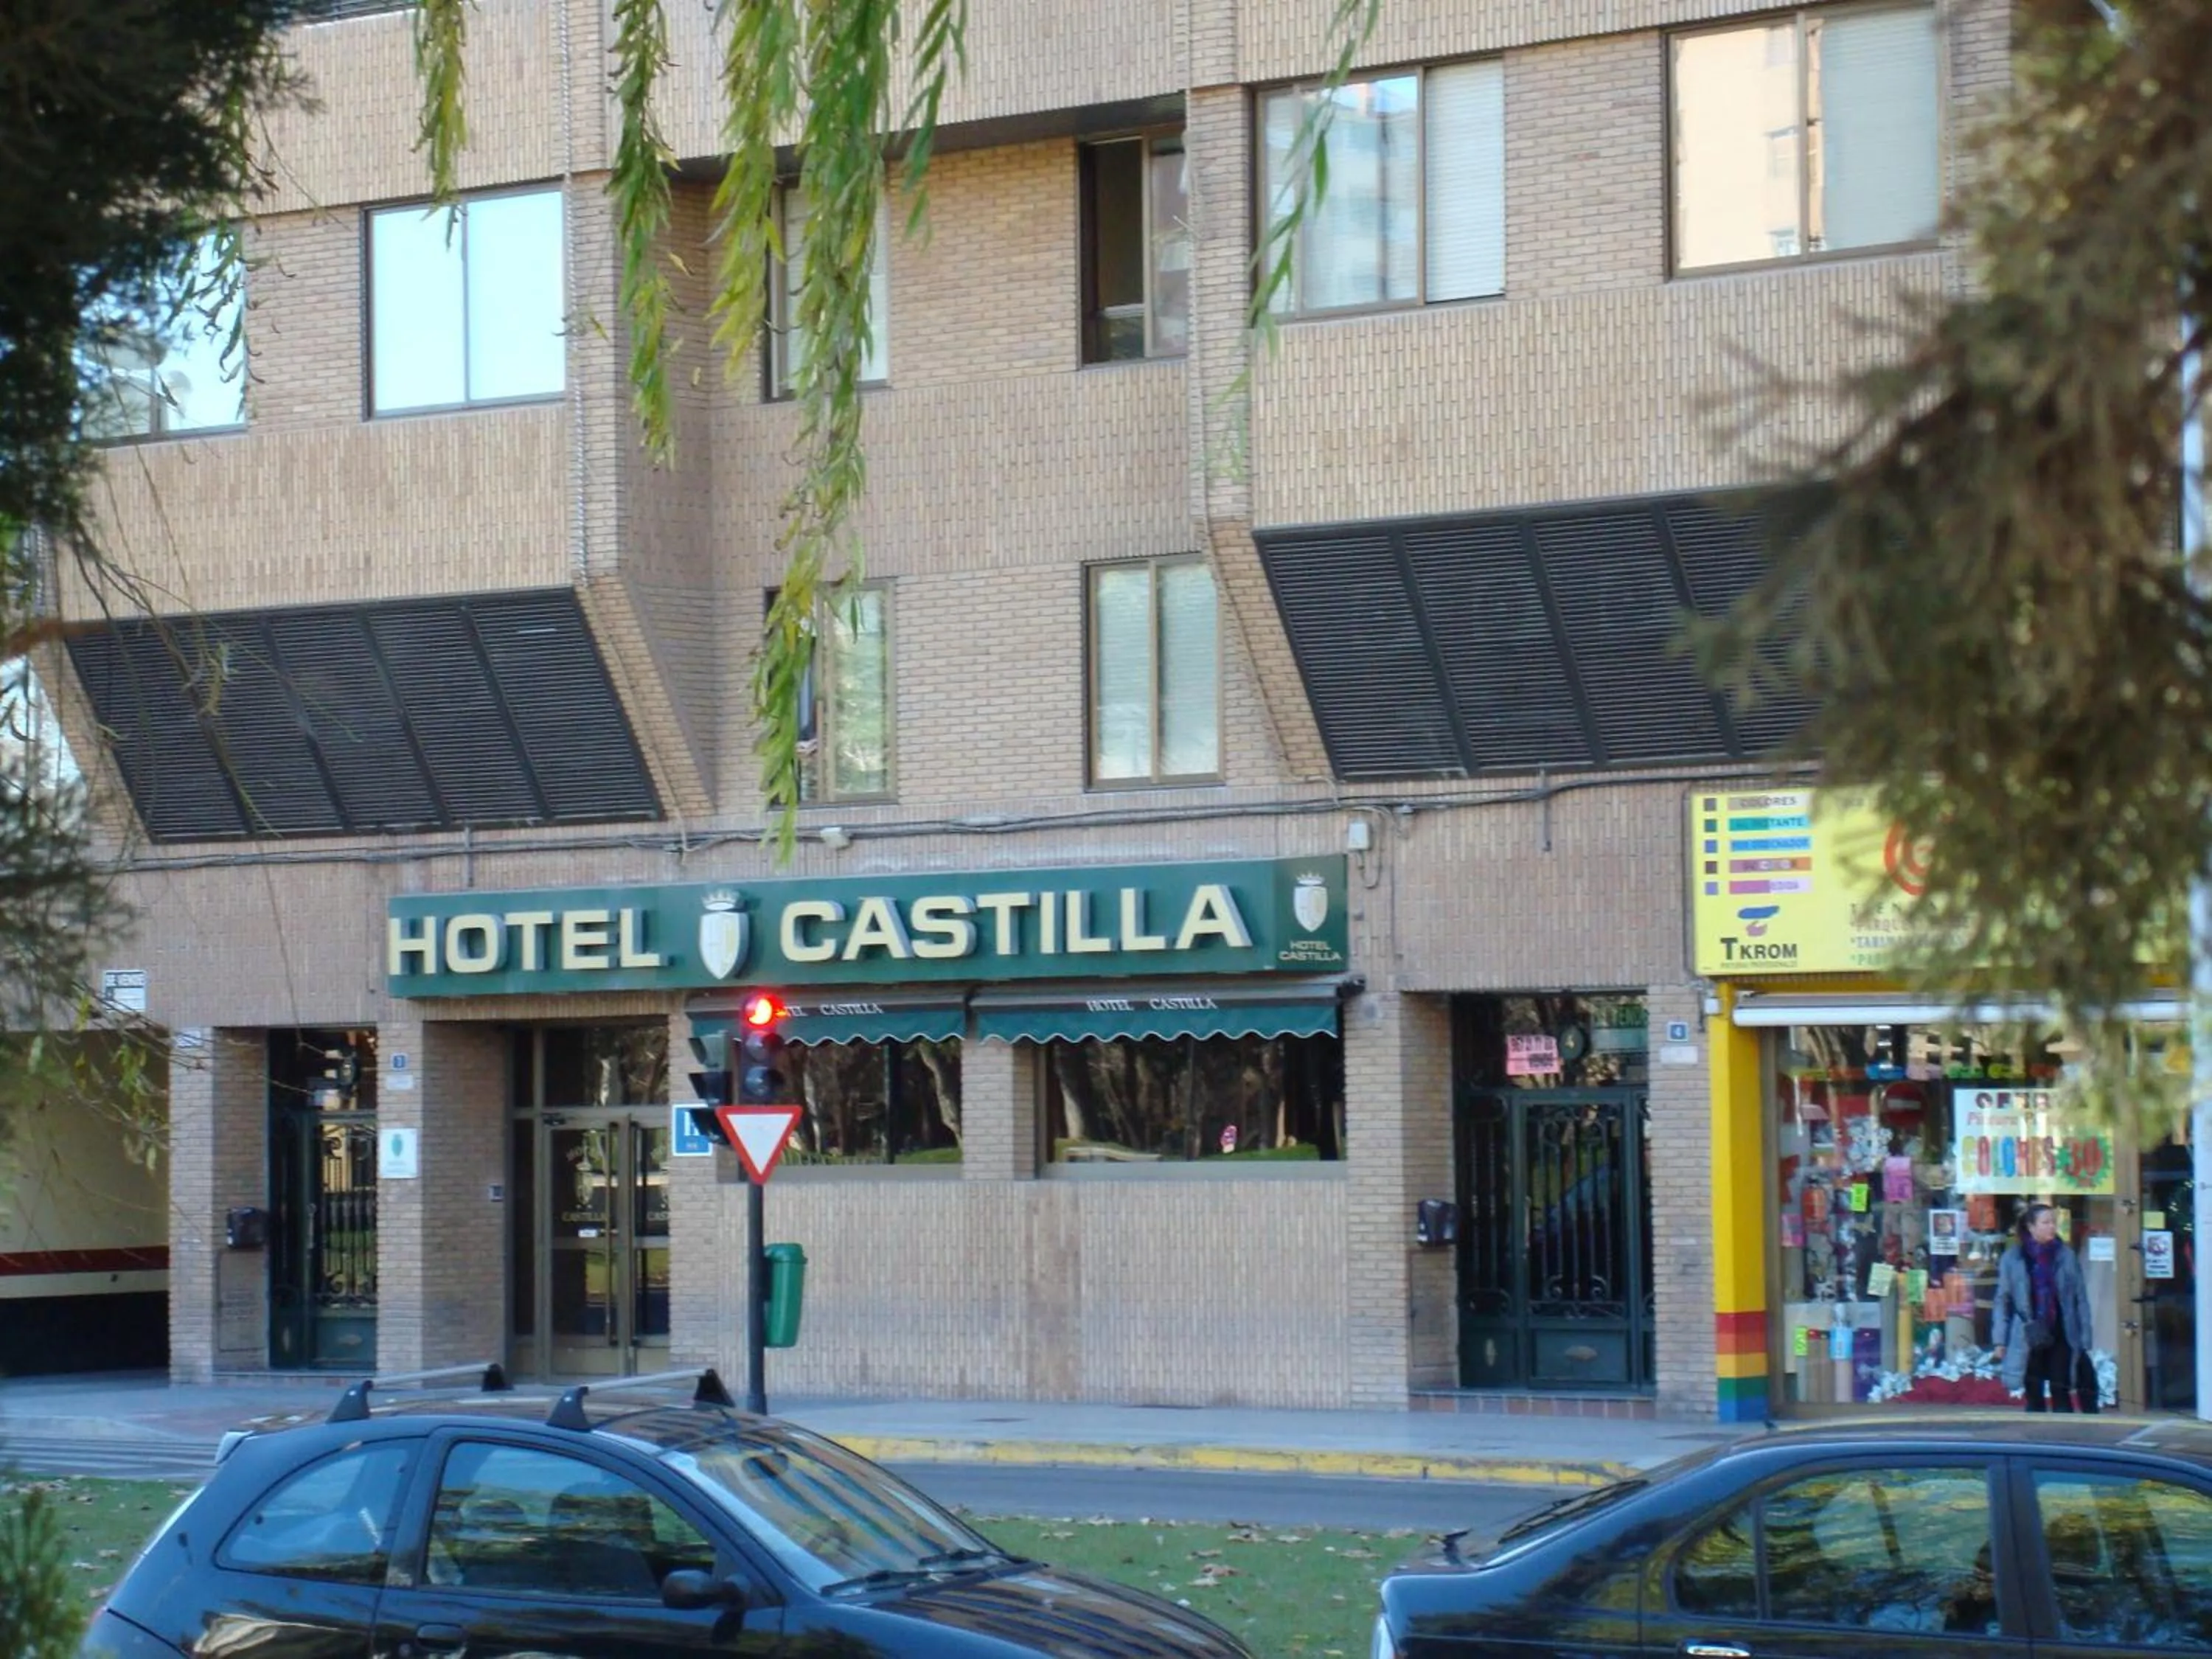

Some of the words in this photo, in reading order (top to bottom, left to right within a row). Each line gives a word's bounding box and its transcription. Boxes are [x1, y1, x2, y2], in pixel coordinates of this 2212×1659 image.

[389, 908, 661, 975] HOTEL
[780, 885, 1252, 961] CASTILLA
[1290, 940, 1332, 950] HOTEL
[1720, 937, 1798, 960] TKROM
[1279, 951, 1342, 961] CASTILLA
[820, 1003, 883, 1015] CASTILLA
[1086, 999, 1135, 1012] HOTEL
[1149, 998, 1219, 1010] CASTILLA
[1961, 1135, 2056, 1178] COLORES
